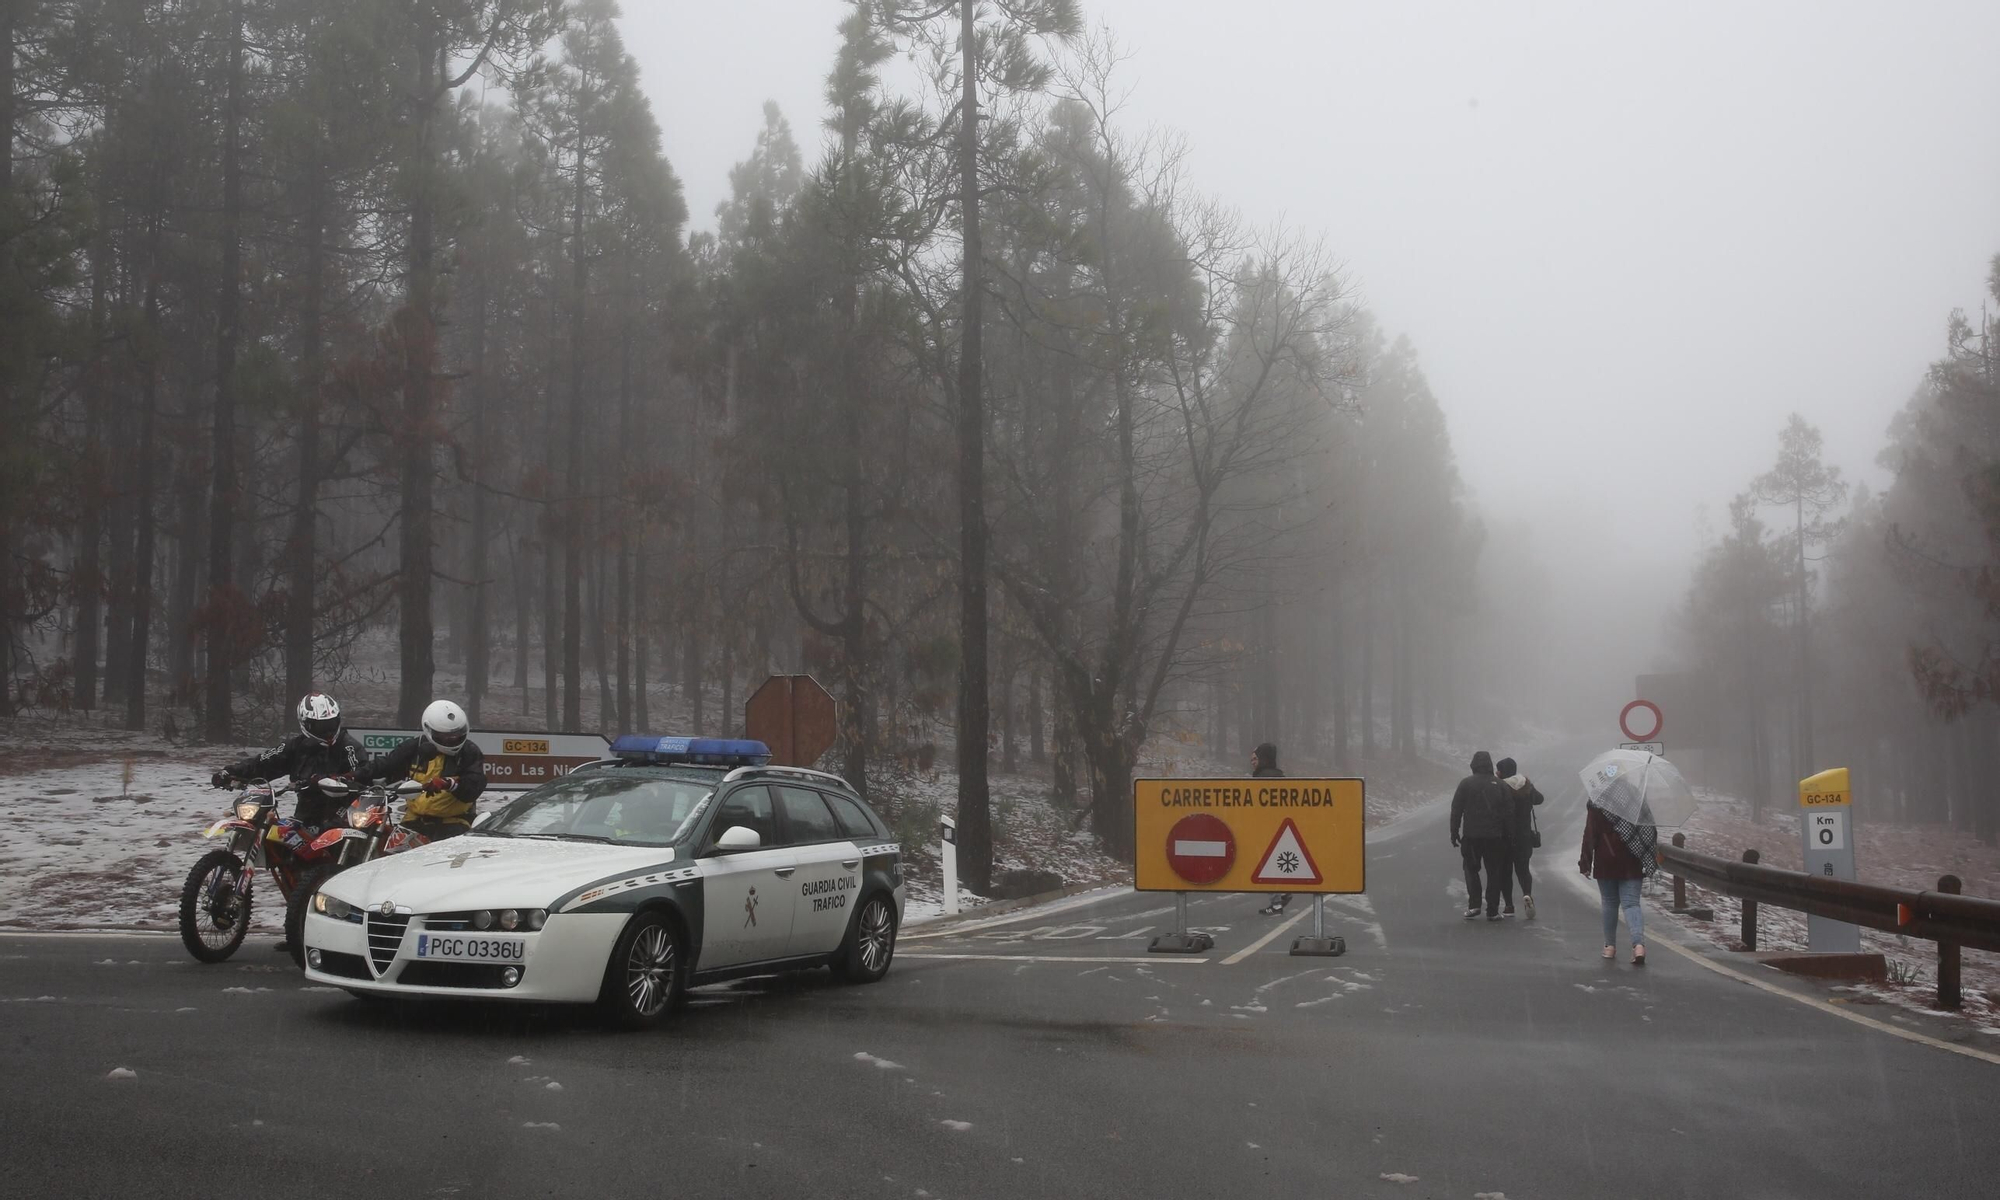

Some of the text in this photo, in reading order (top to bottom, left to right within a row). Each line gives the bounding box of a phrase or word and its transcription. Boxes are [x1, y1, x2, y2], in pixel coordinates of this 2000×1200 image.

[504, 741, 547, 752] GC-134
[482, 763, 513, 775] Pico
[521, 763, 545, 776] Las
[1161, 788, 1333, 807] CARRETERA CERRADA
[1806, 794, 1841, 804] GC-134
[1816, 816, 1834, 825] Km
[1819, 828, 1834, 845] 0
[802, 876, 857, 896] GUARDIA CIVIL
[813, 894, 846, 912] TRAFICO
[431, 938, 464, 956] PGC
[467, 940, 524, 959] 0336U
